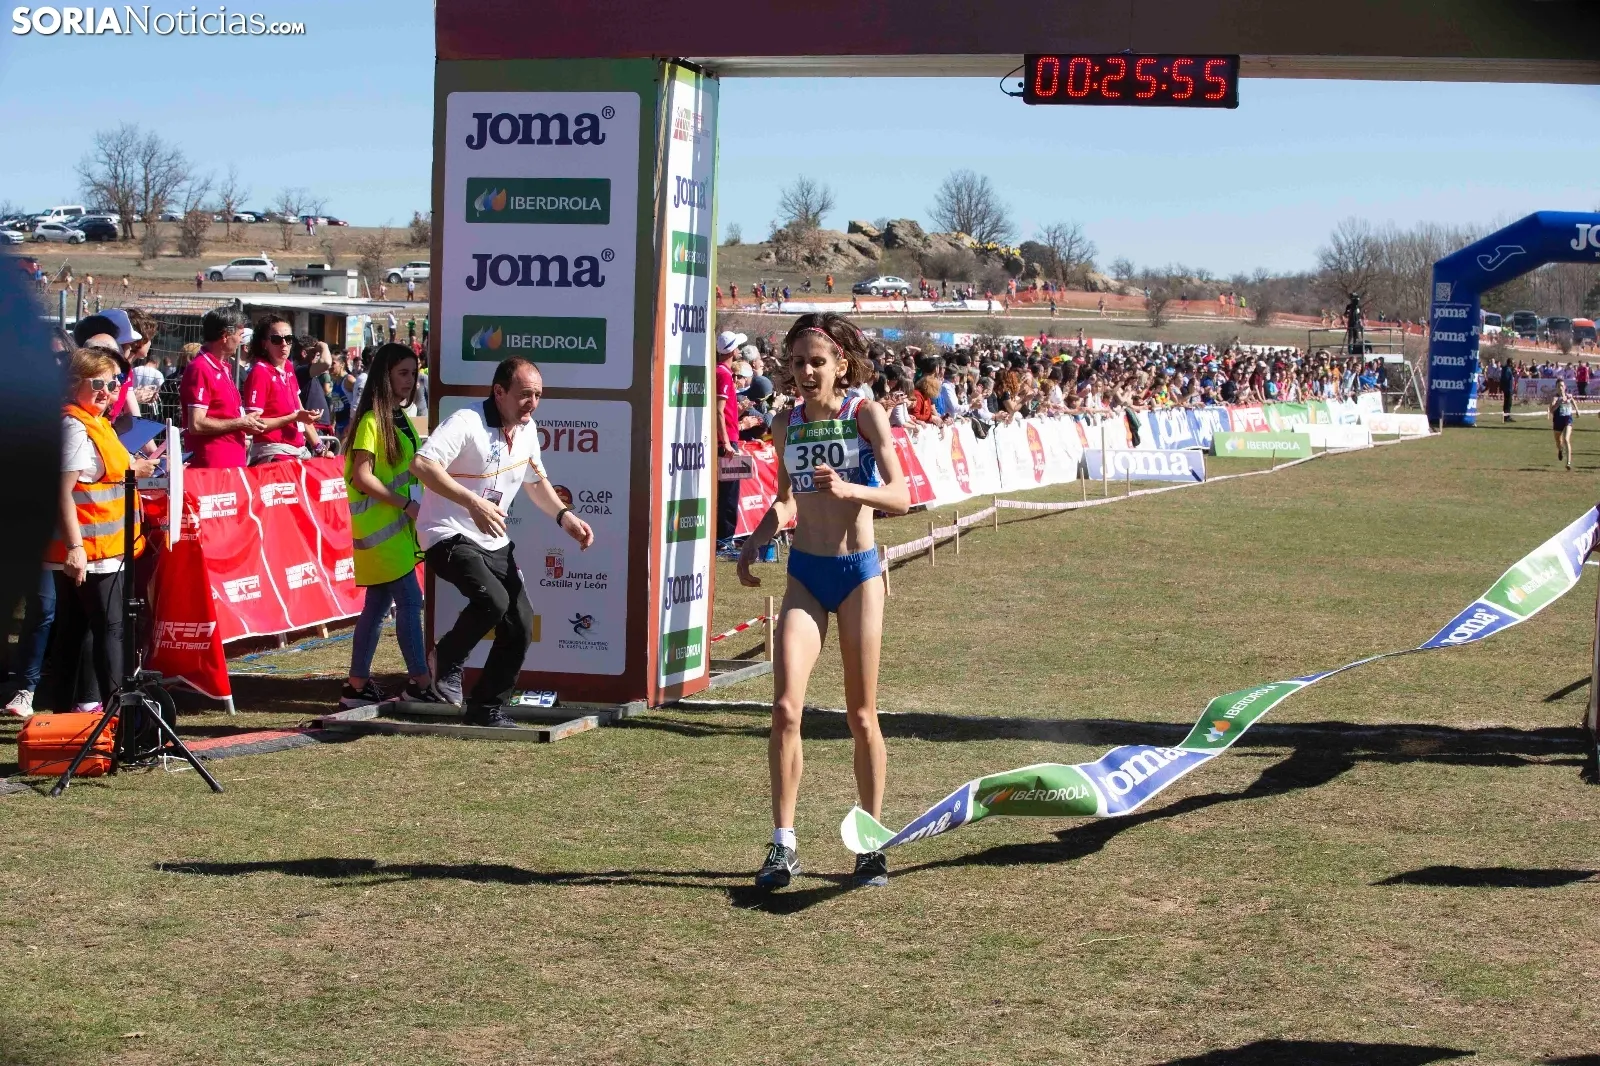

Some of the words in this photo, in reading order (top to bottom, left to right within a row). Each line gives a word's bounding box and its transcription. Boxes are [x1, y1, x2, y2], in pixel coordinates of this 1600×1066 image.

[1035, 57, 1227, 99] 00:25:55
[510, 196, 602, 211] IBERDROLA
[506, 334, 598, 350] IBERDROLA
[535, 419, 599, 429] YUNTAMIENTO
[806, 426, 853, 437] IBERDROLA
[537, 427, 599, 453] oria
[1247, 440, 1301, 450] IBERDROLA
[795, 442, 845, 471] 380
[793, 470, 849, 492] Joa
[565, 571, 593, 580] Junta
[595, 572, 608, 580] de
[539, 579, 573, 588] Castilla
[575, 582, 582, 590] y
[584, 580, 608, 590] León
[1009, 784, 1091, 802] IBERDROLA
